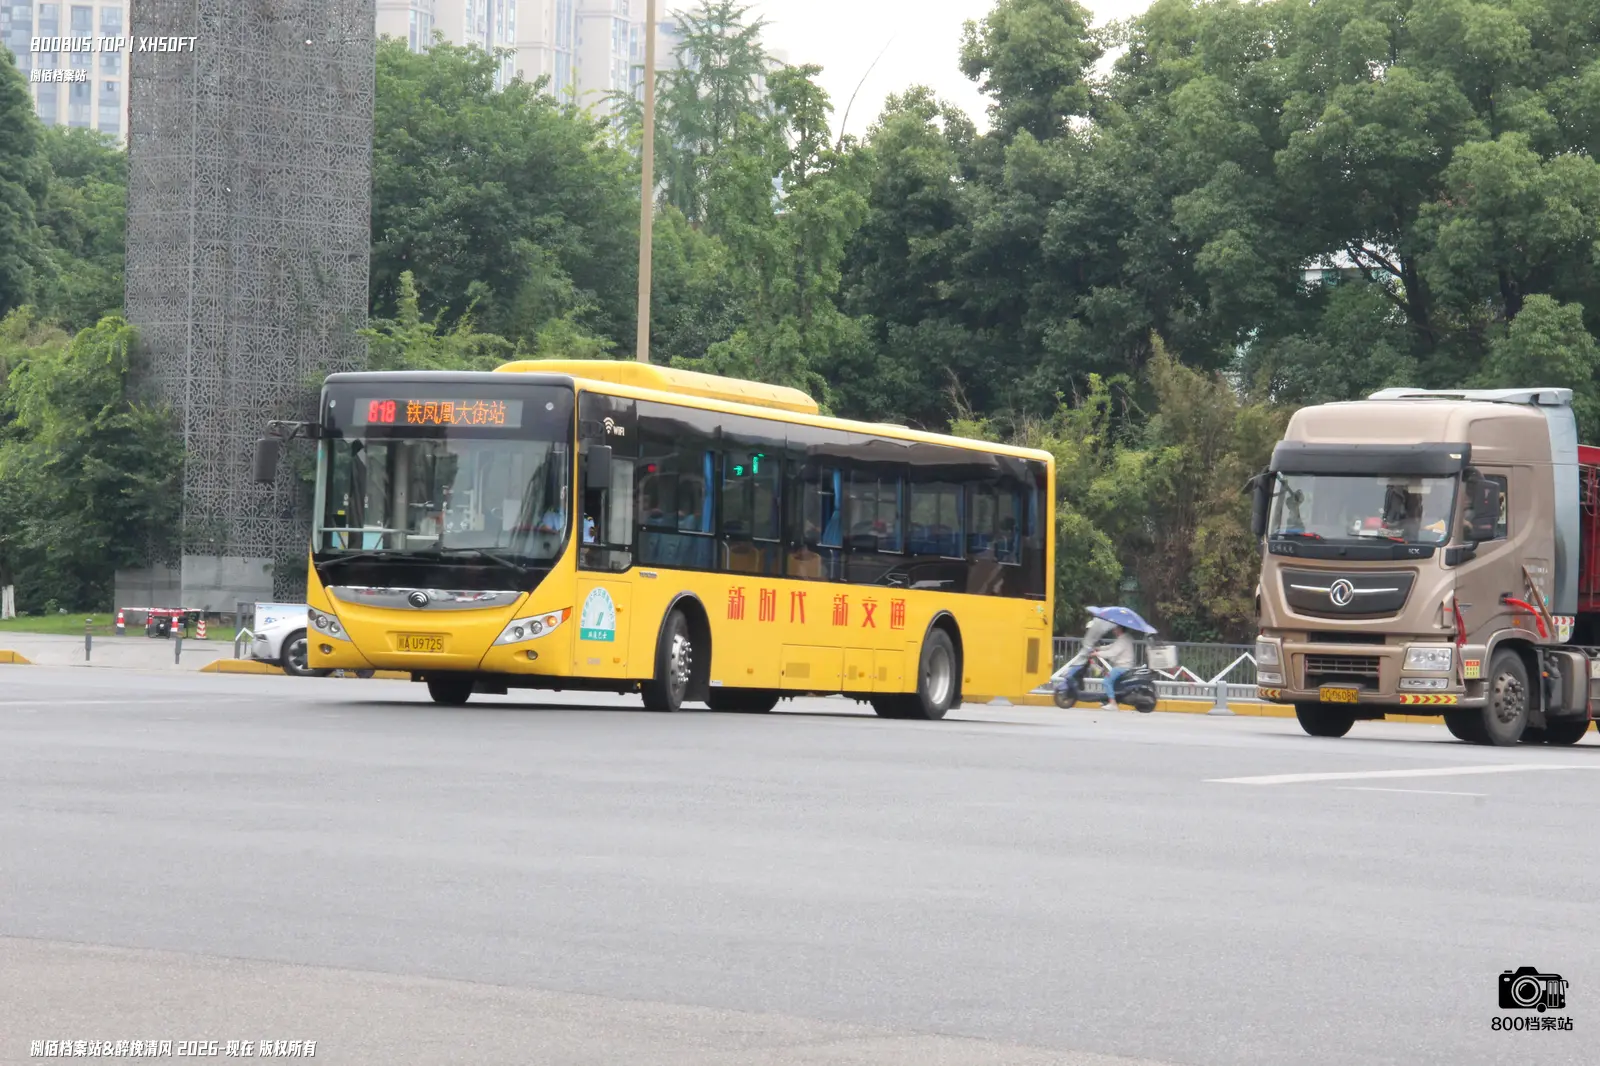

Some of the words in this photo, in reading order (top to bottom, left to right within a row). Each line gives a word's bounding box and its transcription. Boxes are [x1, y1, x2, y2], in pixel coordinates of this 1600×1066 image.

[368, 399, 397, 423] 818
[406, 399, 507, 425] 铁凤凰大街站
[727, 586, 807, 625] 新时代
[832, 593, 906, 631] 新交通
